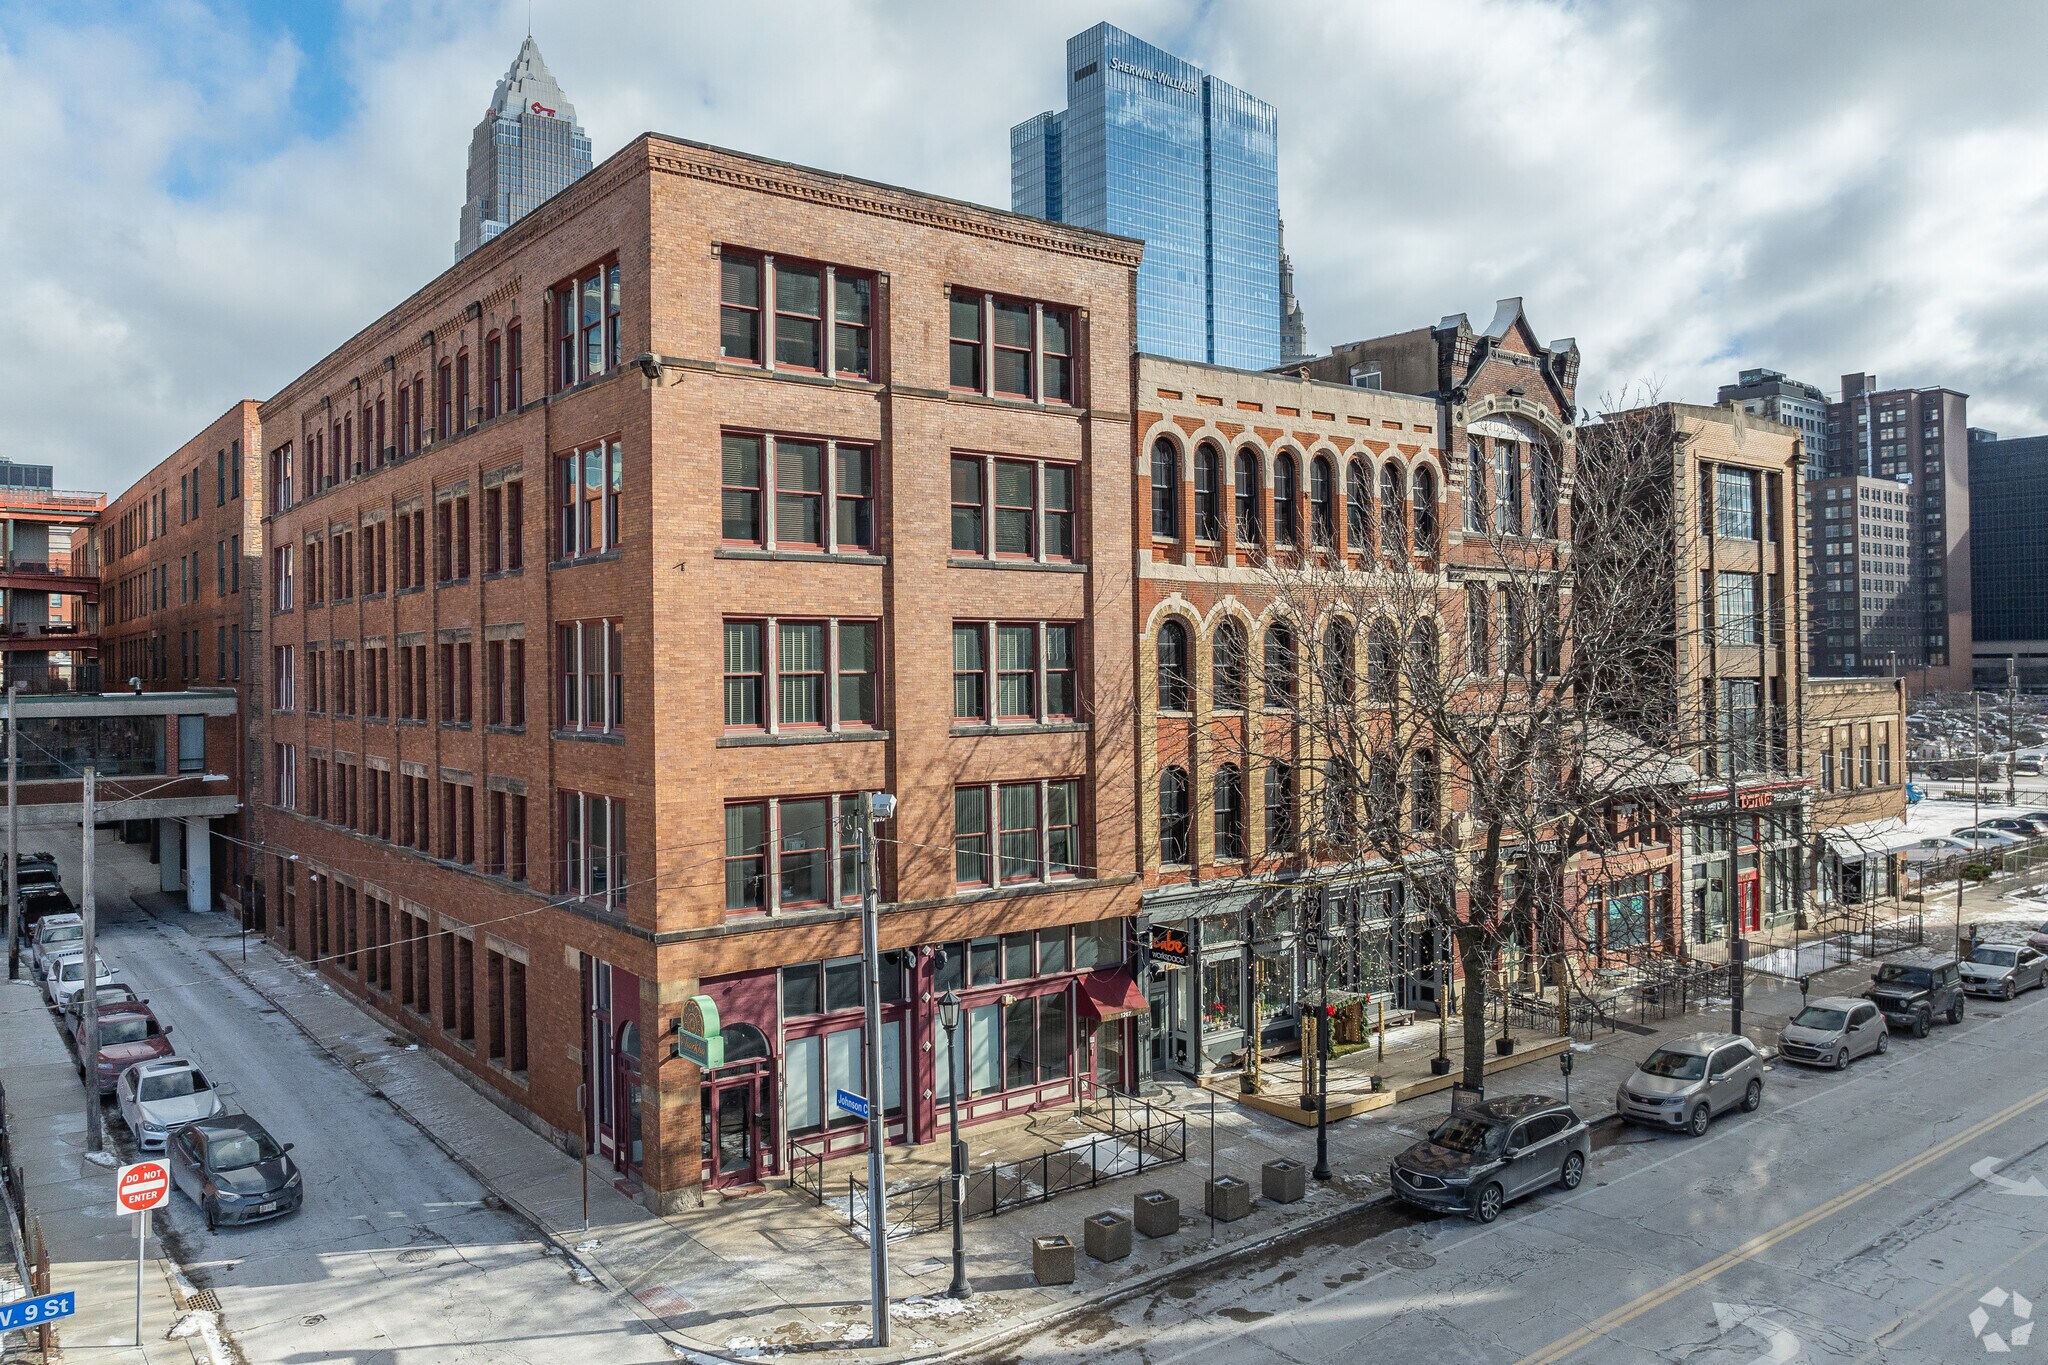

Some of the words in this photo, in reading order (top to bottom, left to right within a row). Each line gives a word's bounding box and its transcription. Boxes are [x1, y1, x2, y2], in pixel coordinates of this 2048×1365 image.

[838, 1094, 862, 1112] Johnson
[126, 1174, 139, 1184] DO
[143, 1169, 162, 1180] NOT
[128, 1190, 158, 1204] ENTER
[24, 1304, 38, 1322] 9
[44, 1298, 69, 1317] St
